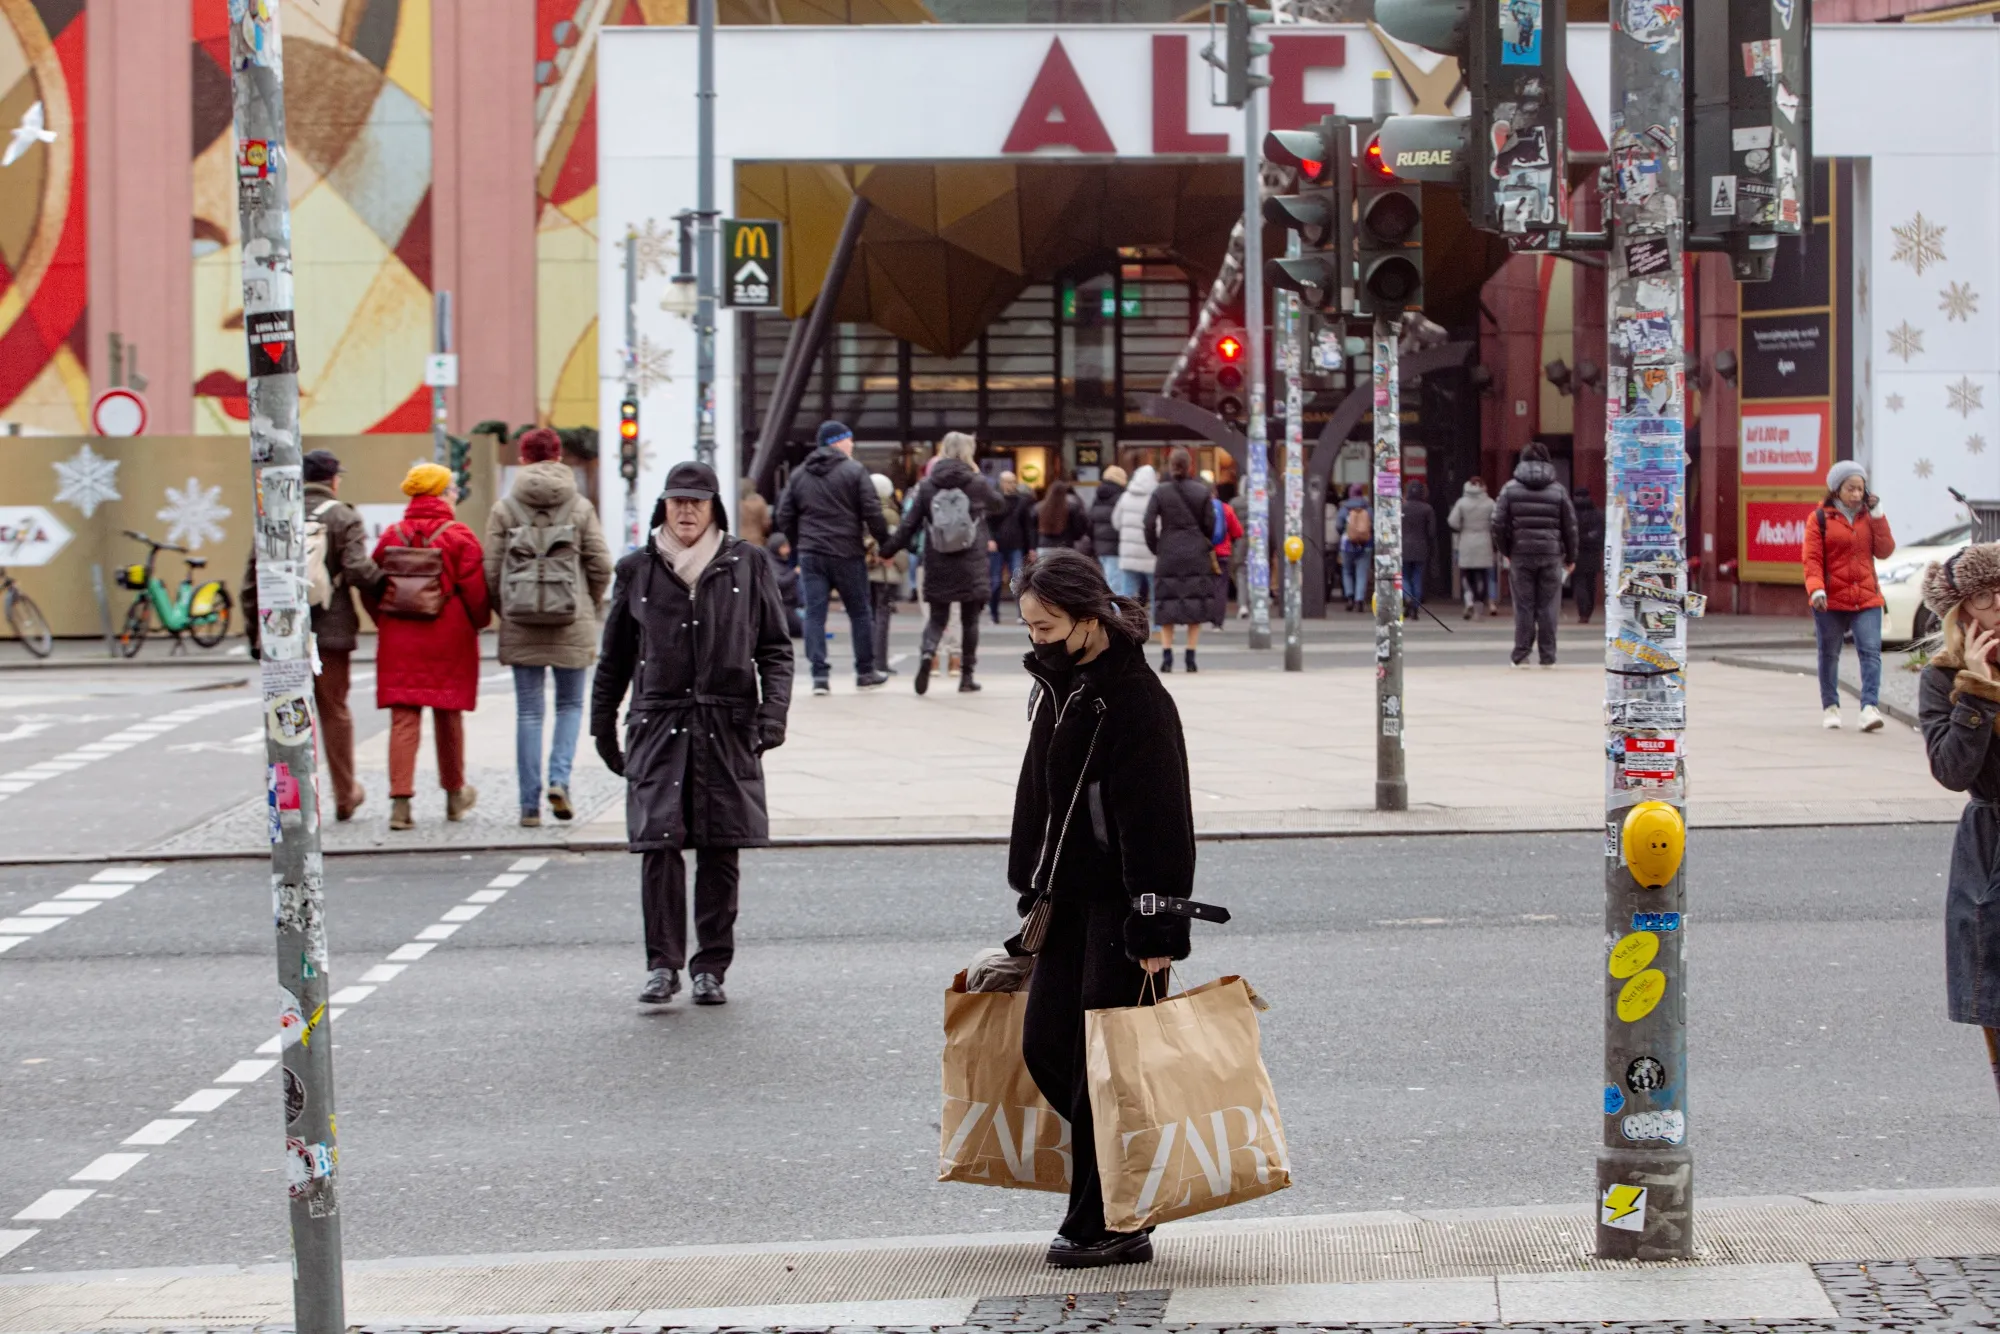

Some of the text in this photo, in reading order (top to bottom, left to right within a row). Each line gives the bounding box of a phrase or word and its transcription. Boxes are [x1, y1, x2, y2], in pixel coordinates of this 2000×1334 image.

[1396, 149, 1452, 166] RUBAE
[1636, 740, 1666, 748] HELLO
[941, 1096, 1072, 1185] ZAR
